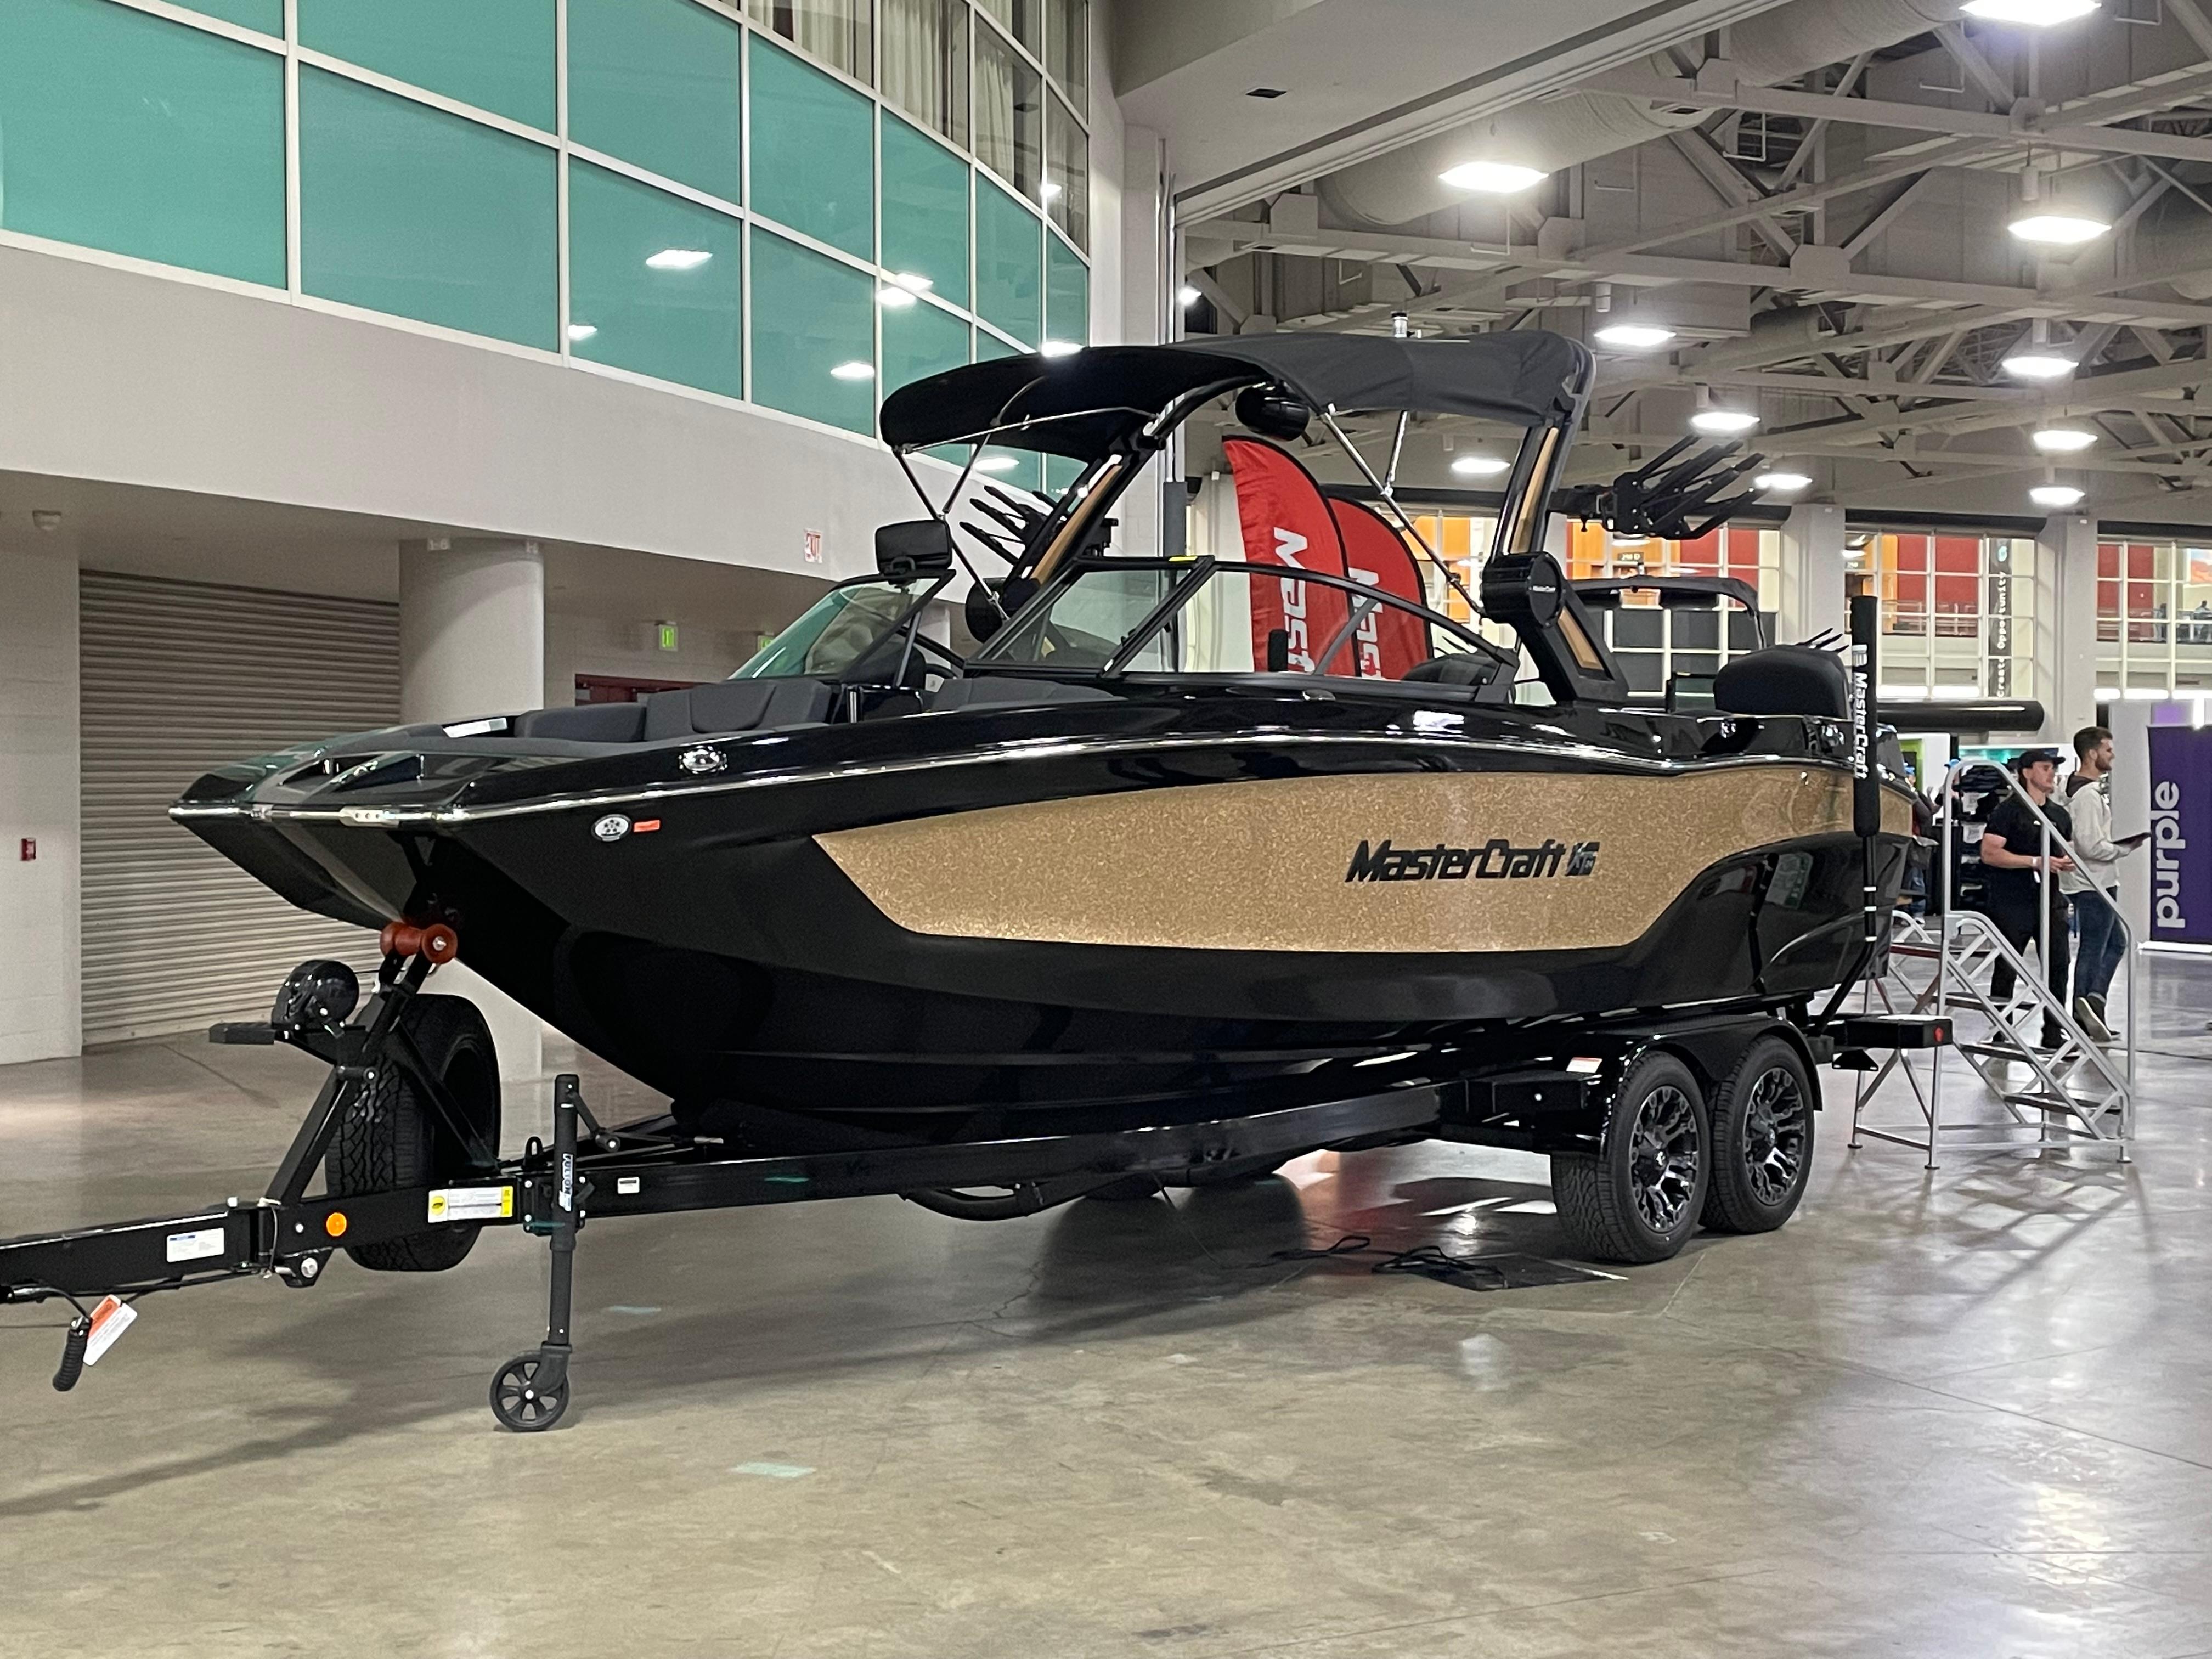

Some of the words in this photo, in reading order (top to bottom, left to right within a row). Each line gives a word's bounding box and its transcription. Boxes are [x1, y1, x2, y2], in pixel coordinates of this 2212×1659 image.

[1348, 567, 1384, 680] Mas
[1997, 571, 2007, 650] Oppotunity
[1854, 672, 1868, 780] MasterCraft
[1345, 839, 1566, 883] MasterCraft
[2151, 781, 2186, 929] purple
